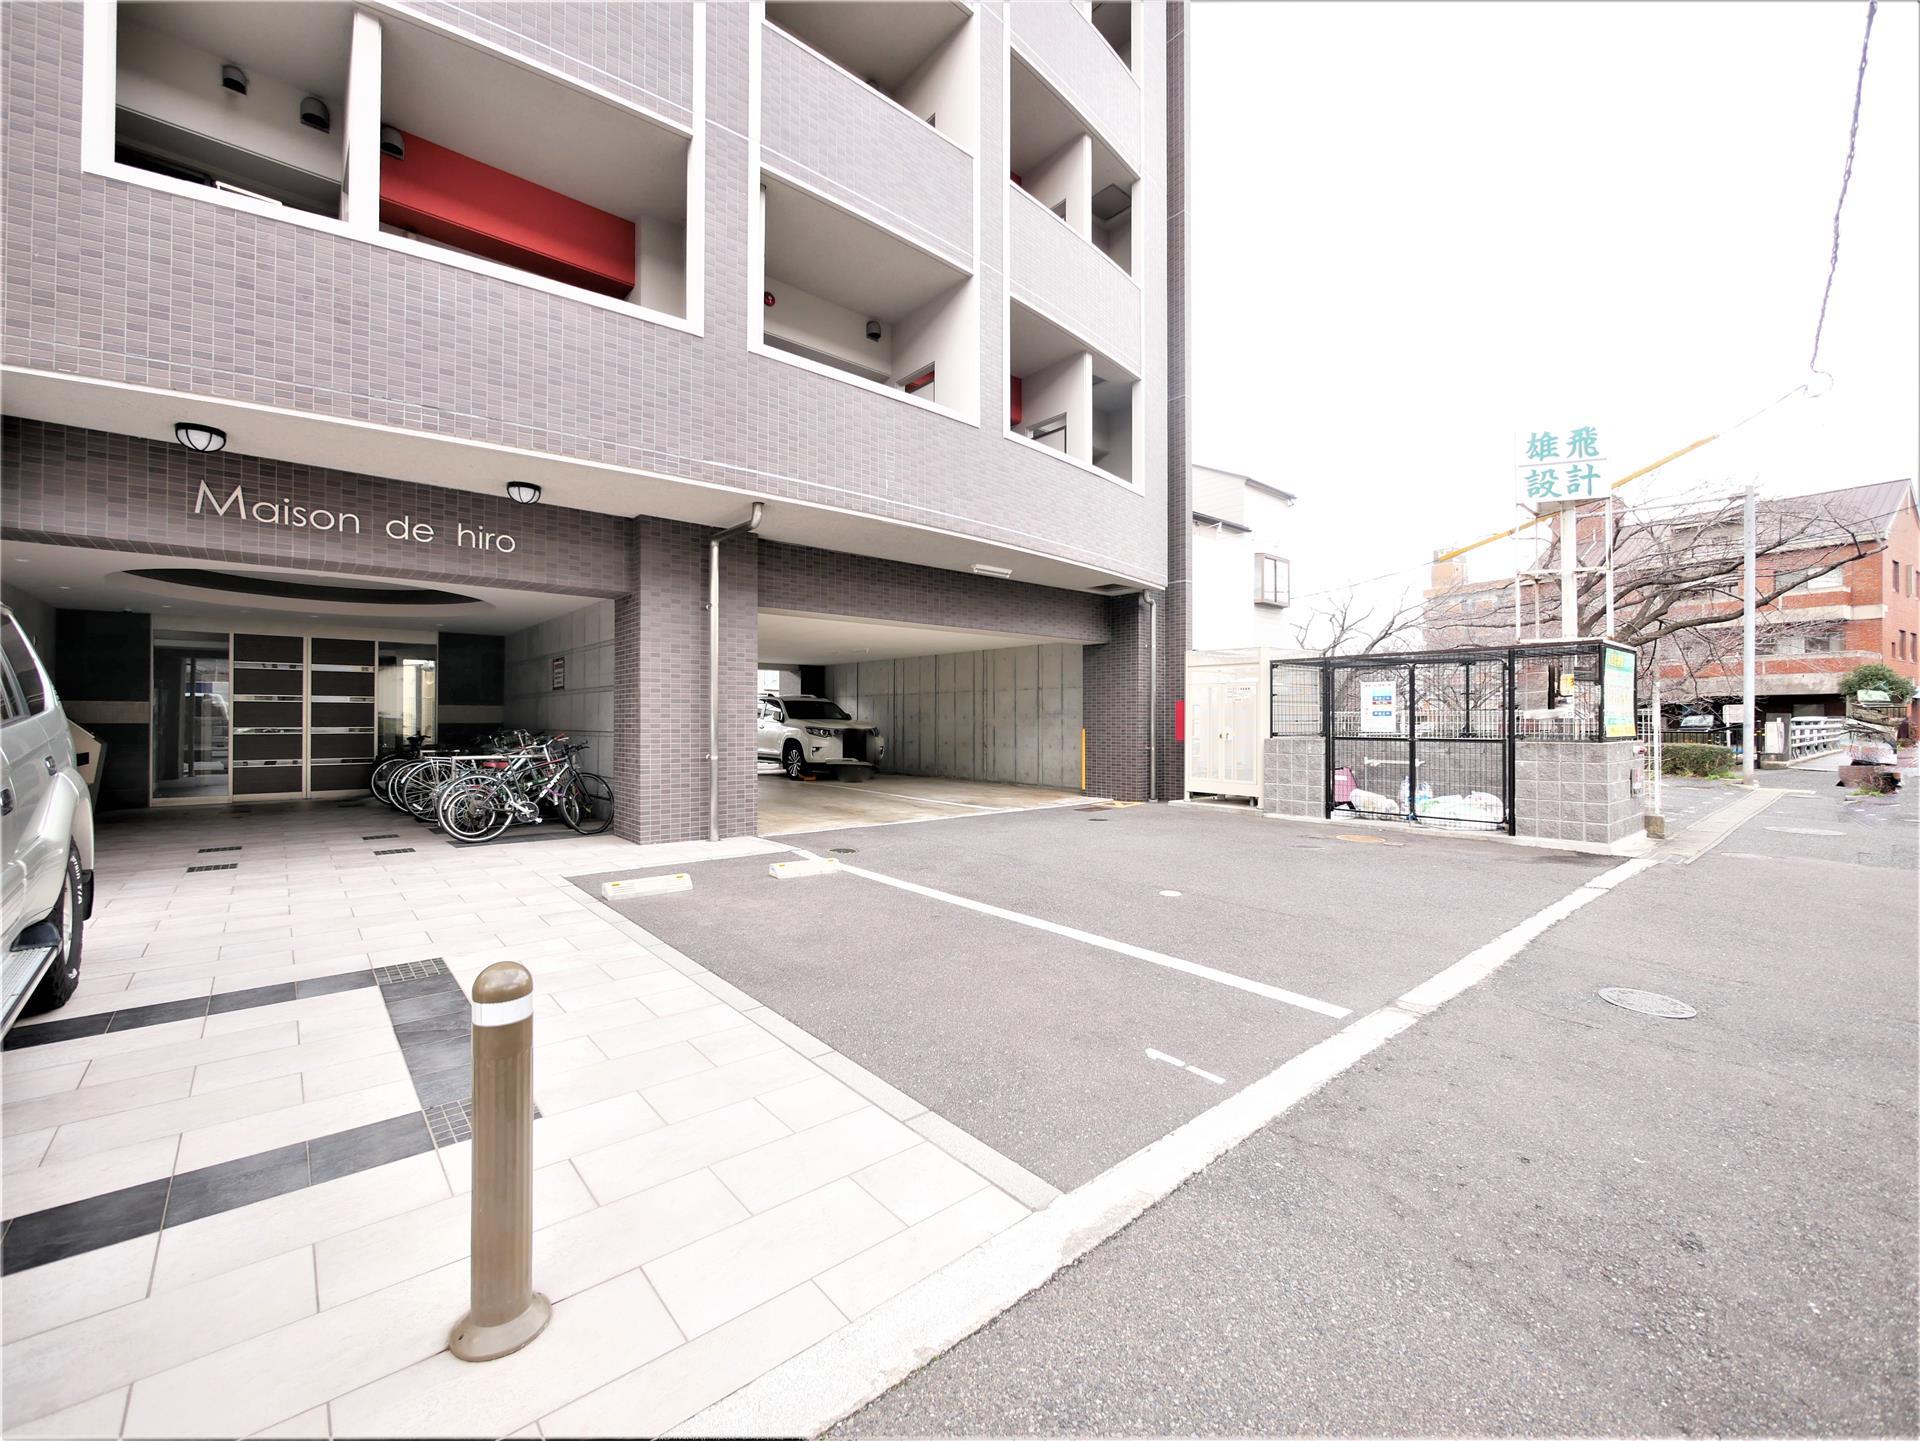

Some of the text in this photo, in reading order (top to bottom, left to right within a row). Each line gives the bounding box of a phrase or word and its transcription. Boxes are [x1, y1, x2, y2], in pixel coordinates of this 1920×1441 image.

[1526, 425, 1600, 461] 雄飛
[1524, 463, 1602, 498] 設計
[194, 479, 516, 553] Maison de hiro
